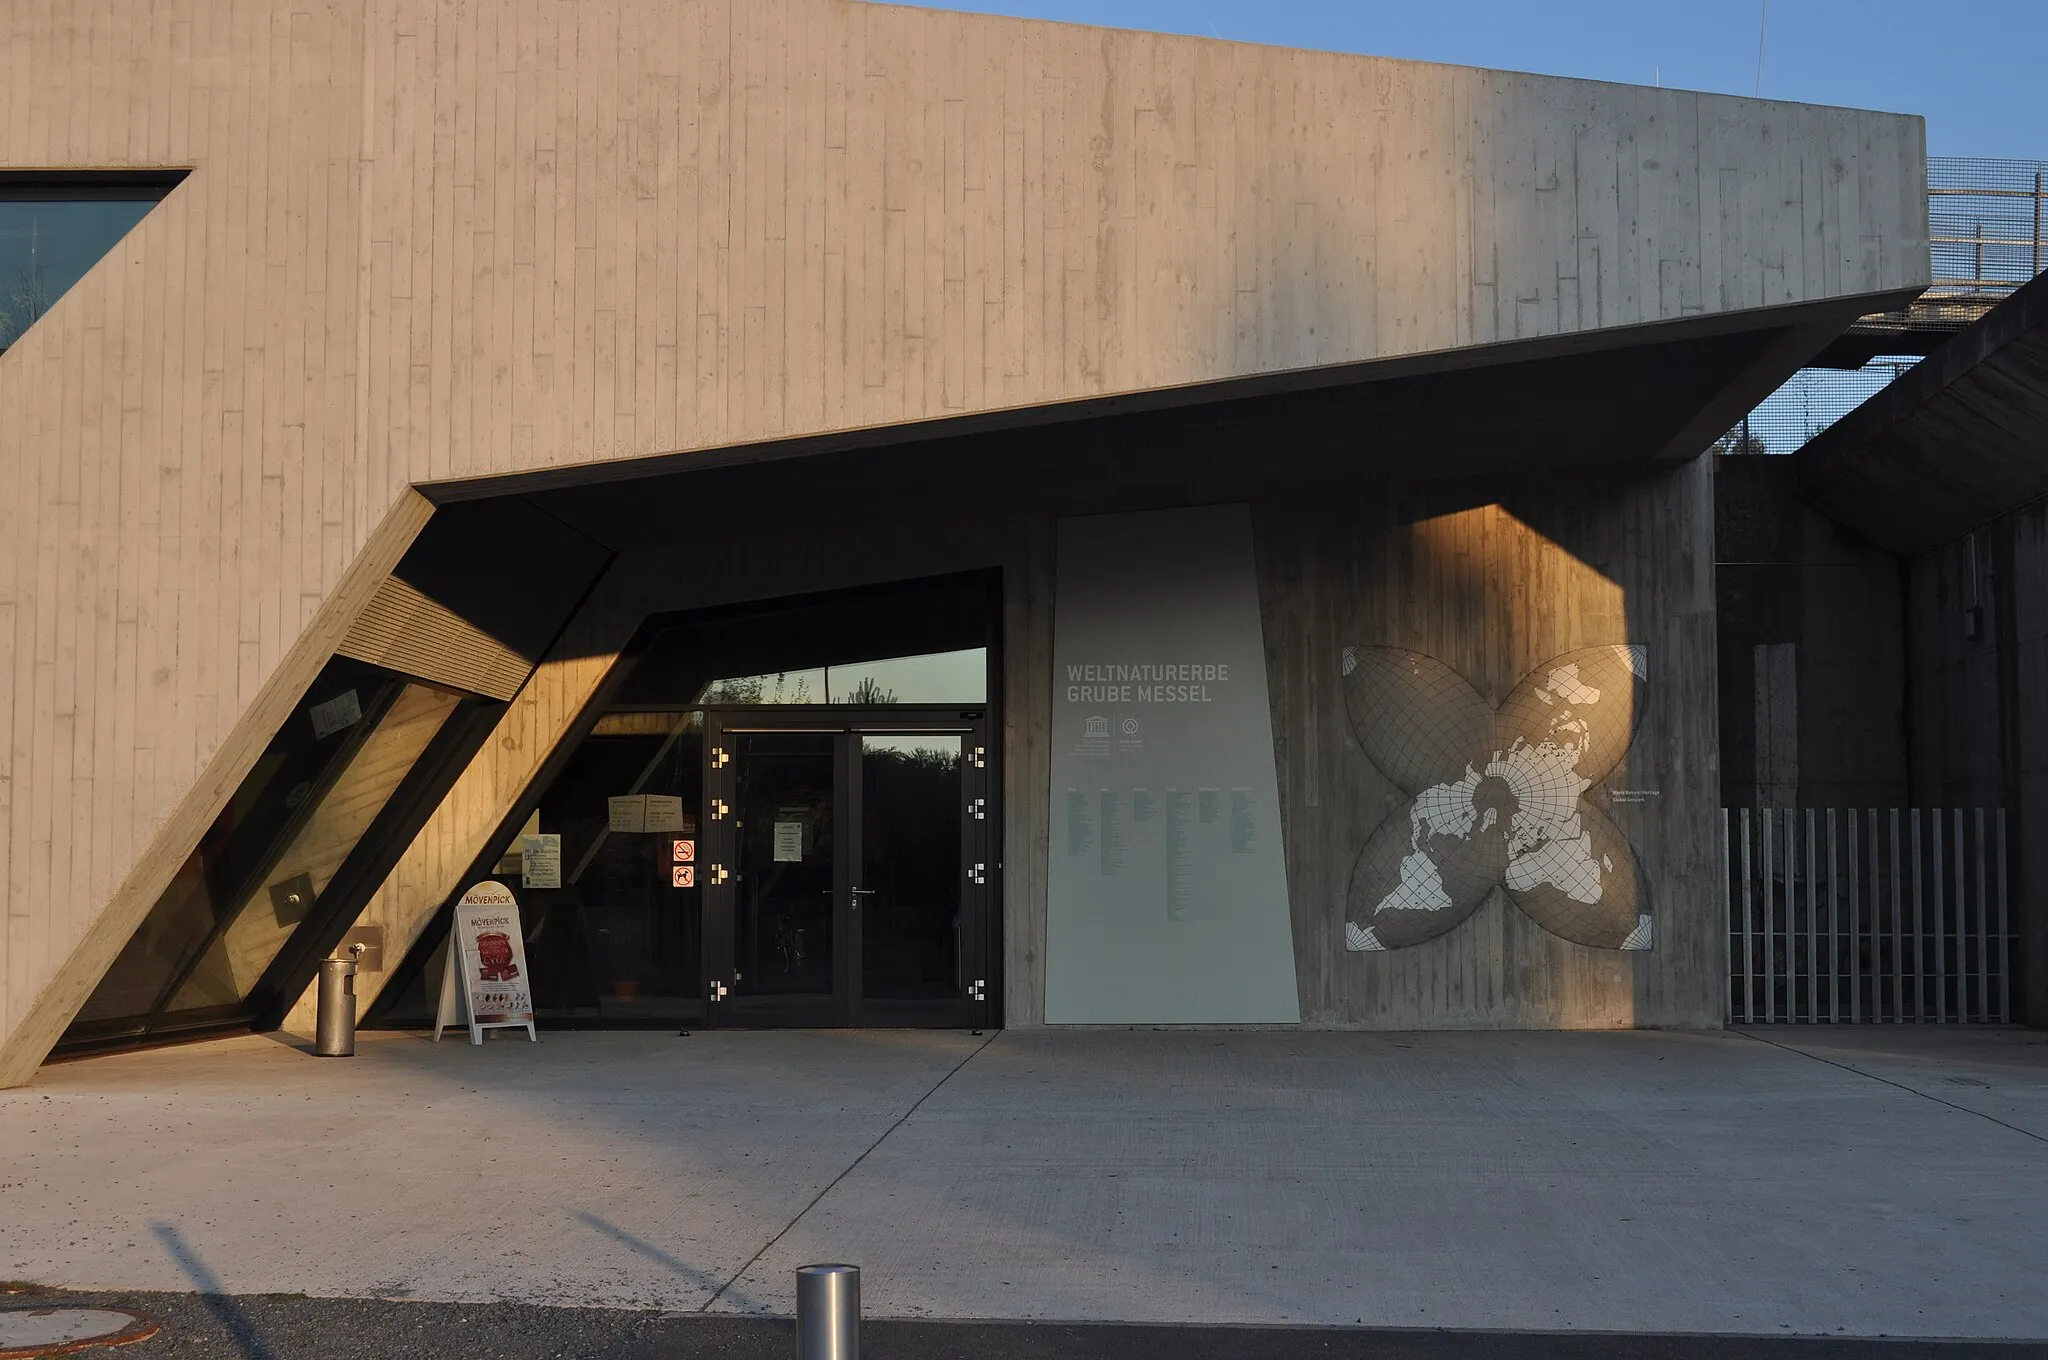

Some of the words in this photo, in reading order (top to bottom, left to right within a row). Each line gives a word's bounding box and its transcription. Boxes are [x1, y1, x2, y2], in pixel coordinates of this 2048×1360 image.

[1067, 664, 1228, 681] WELTNATURERBE
[1067, 686, 1131, 702] GRUBE
[1138, 686, 1211, 702] MESSEL
[465, 894, 511, 904] MÖVENPICK
[471, 916, 509, 926] MÖVENPICK
